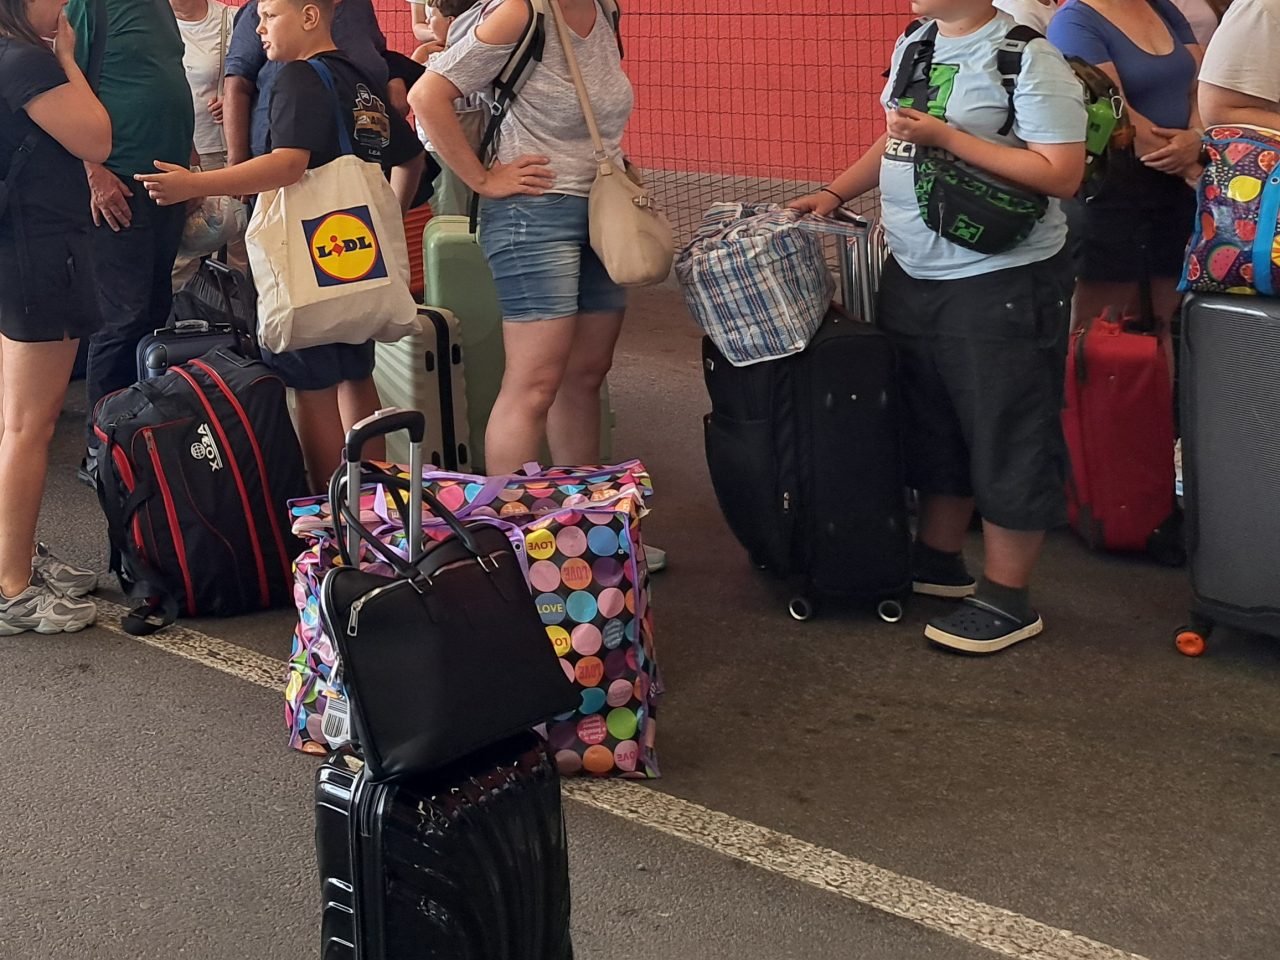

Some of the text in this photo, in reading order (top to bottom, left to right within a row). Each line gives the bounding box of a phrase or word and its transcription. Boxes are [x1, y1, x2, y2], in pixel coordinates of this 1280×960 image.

[527, 541, 554, 551] LOVE
[537, 603, 563, 613] LOVE
[554, 637, 568, 646] LO
[616, 751, 636, 761] OVE
